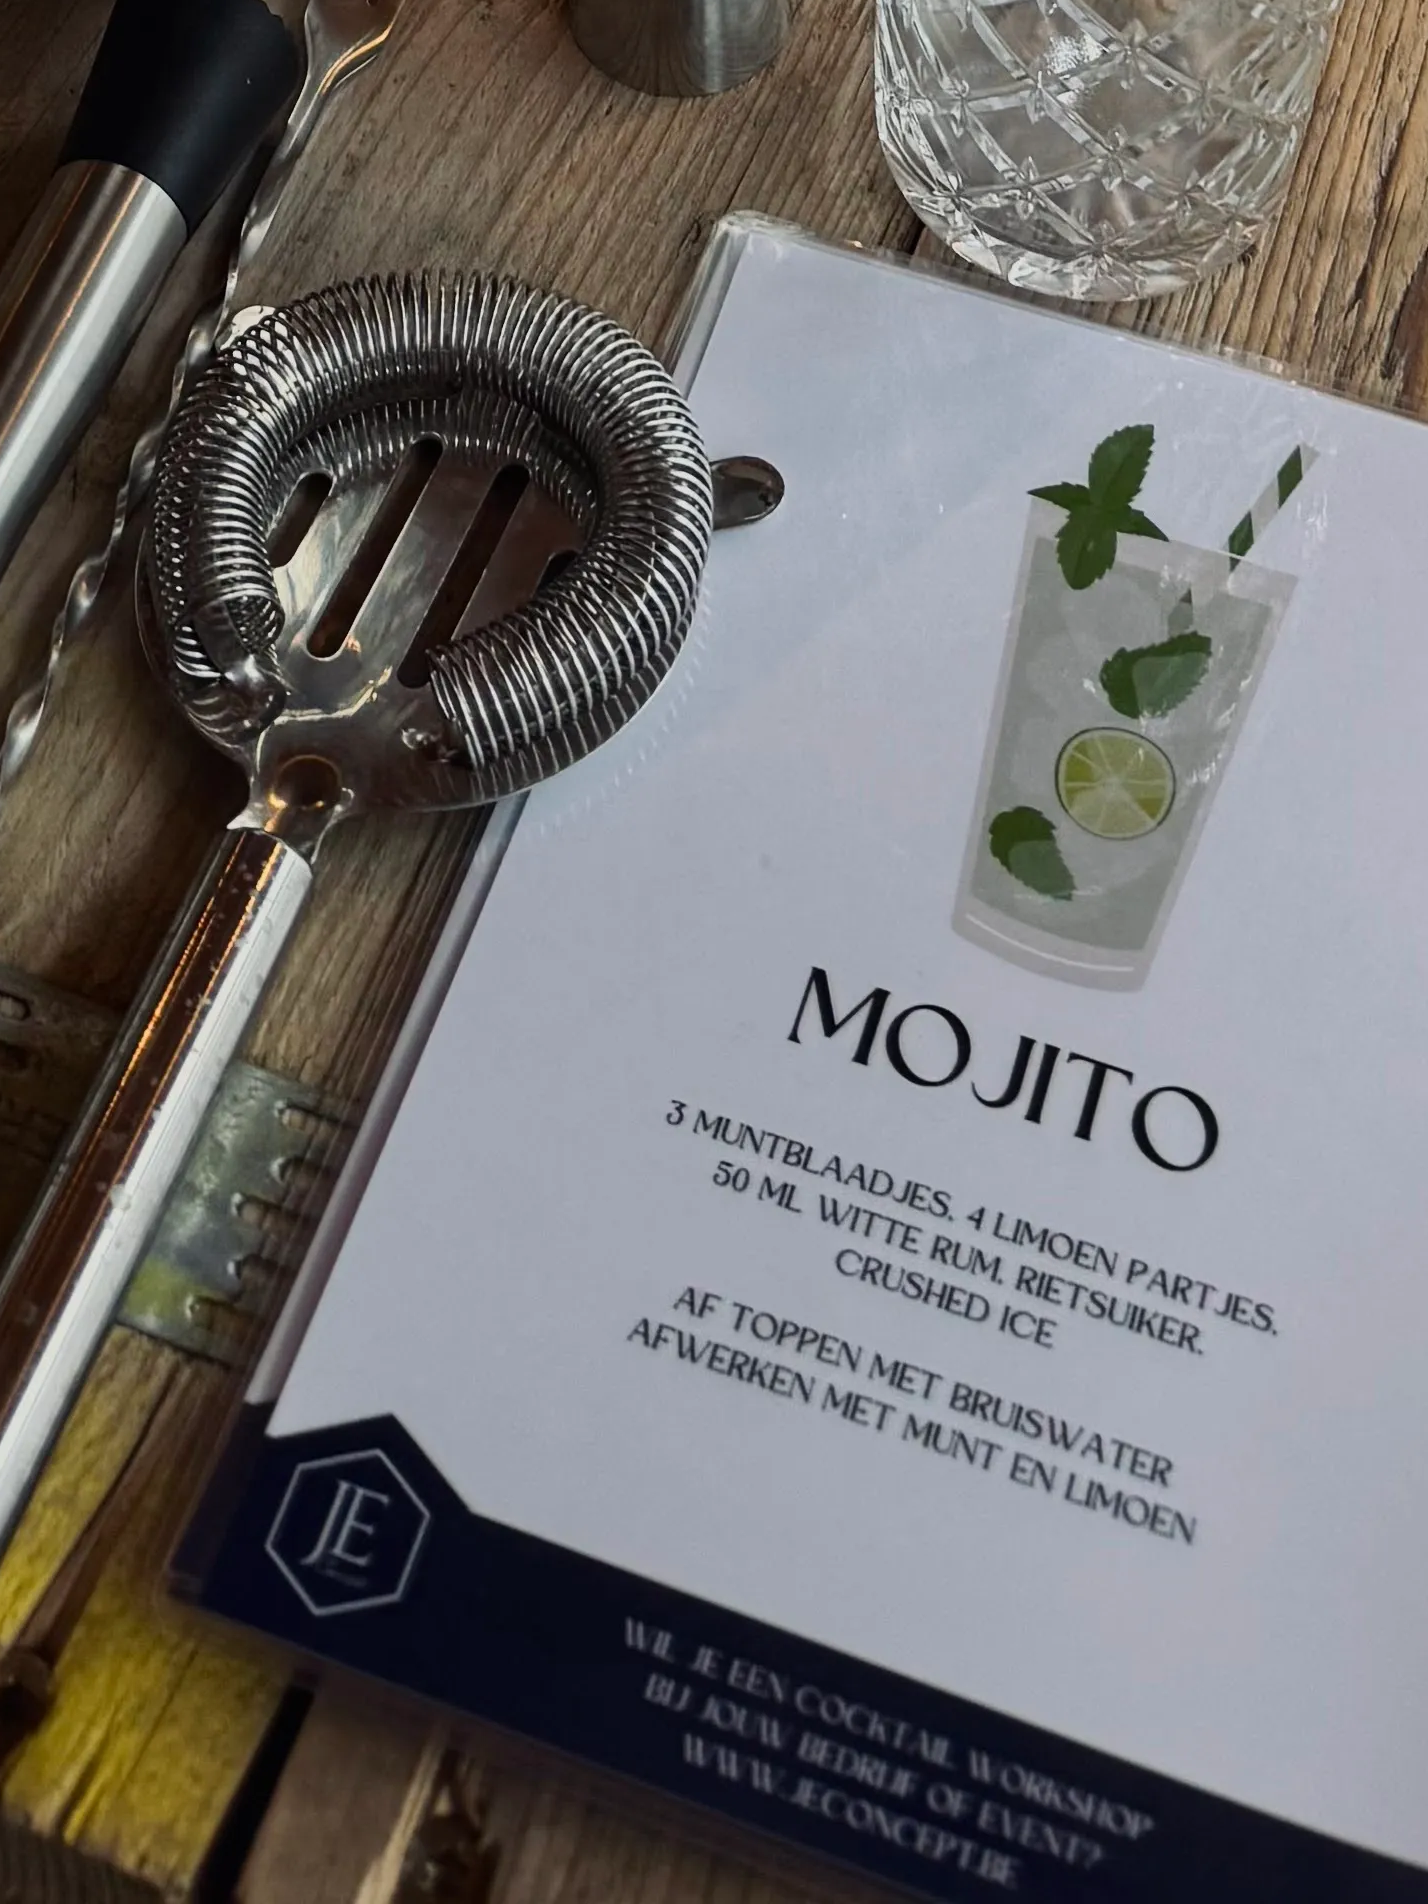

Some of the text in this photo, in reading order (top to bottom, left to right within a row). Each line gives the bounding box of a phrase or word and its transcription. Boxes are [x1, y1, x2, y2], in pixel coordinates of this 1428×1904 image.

[787, 966, 1220, 1172] MOJITO
[666, 1099, 687, 1126] 3
[967, 1206, 986, 1231] 4
[992, 1212, 1119, 1277] LIMOEN
[713, 1160, 750, 1193] 50
[758, 1176, 802, 1213] ML
[819, 1194, 923, 1254] WITTE
[673, 1287, 1174, 1488] AF TOPPEN MET BRUISWATER
[835, 1248, 1058, 1349] CRUSHED ICE
[627, 1318, 1197, 1545] AFWERKEN MET MUNT EN LIMOEN
[625, 1617, 1156, 1840] WIL JE EEN COCKTAIL WORKSHOP
[644, 1673, 1106, 1869] BIJ JOUW BEDRIJF OF EVENT?
[684, 1733, 1018, 1889] WWW.JECONCEPT.BE
